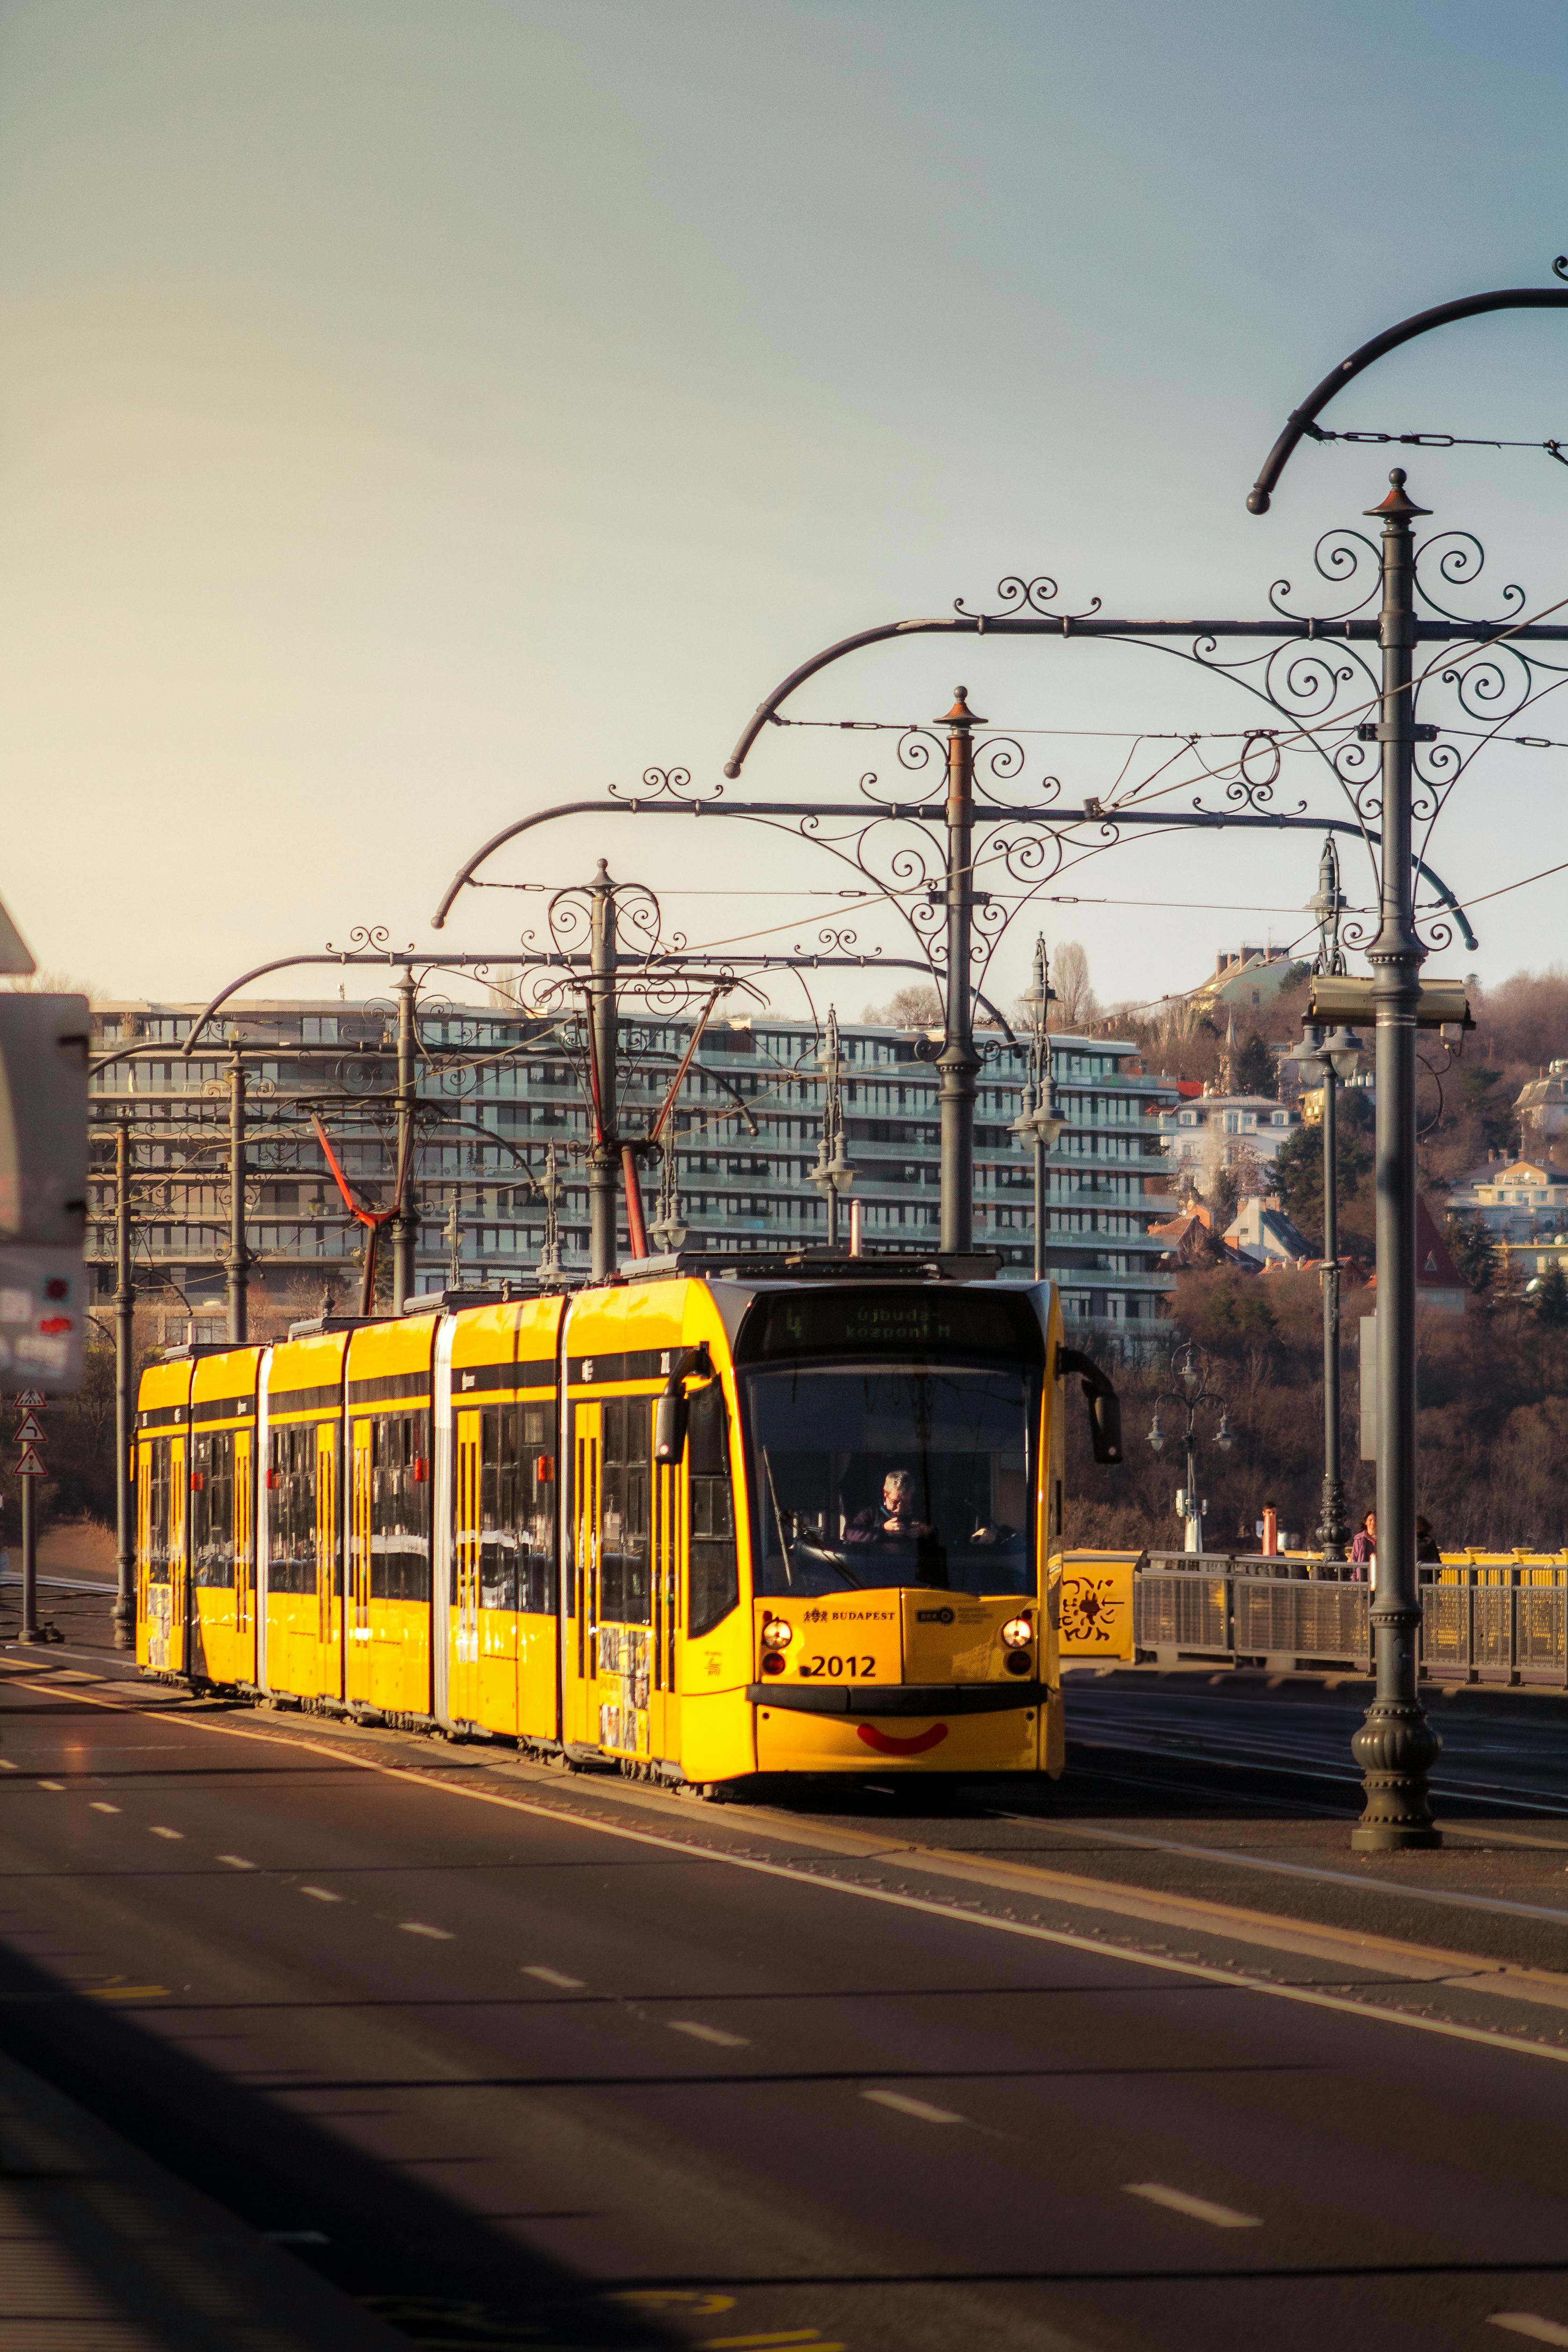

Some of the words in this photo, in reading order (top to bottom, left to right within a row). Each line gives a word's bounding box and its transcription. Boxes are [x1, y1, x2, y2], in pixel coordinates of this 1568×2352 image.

[786, 1306, 801, 1339] 4
[938, 1324, 951, 1338] M
[832, 1612, 895, 1621] BUDAPEST
[811, 1656, 876, 1678] 2012
